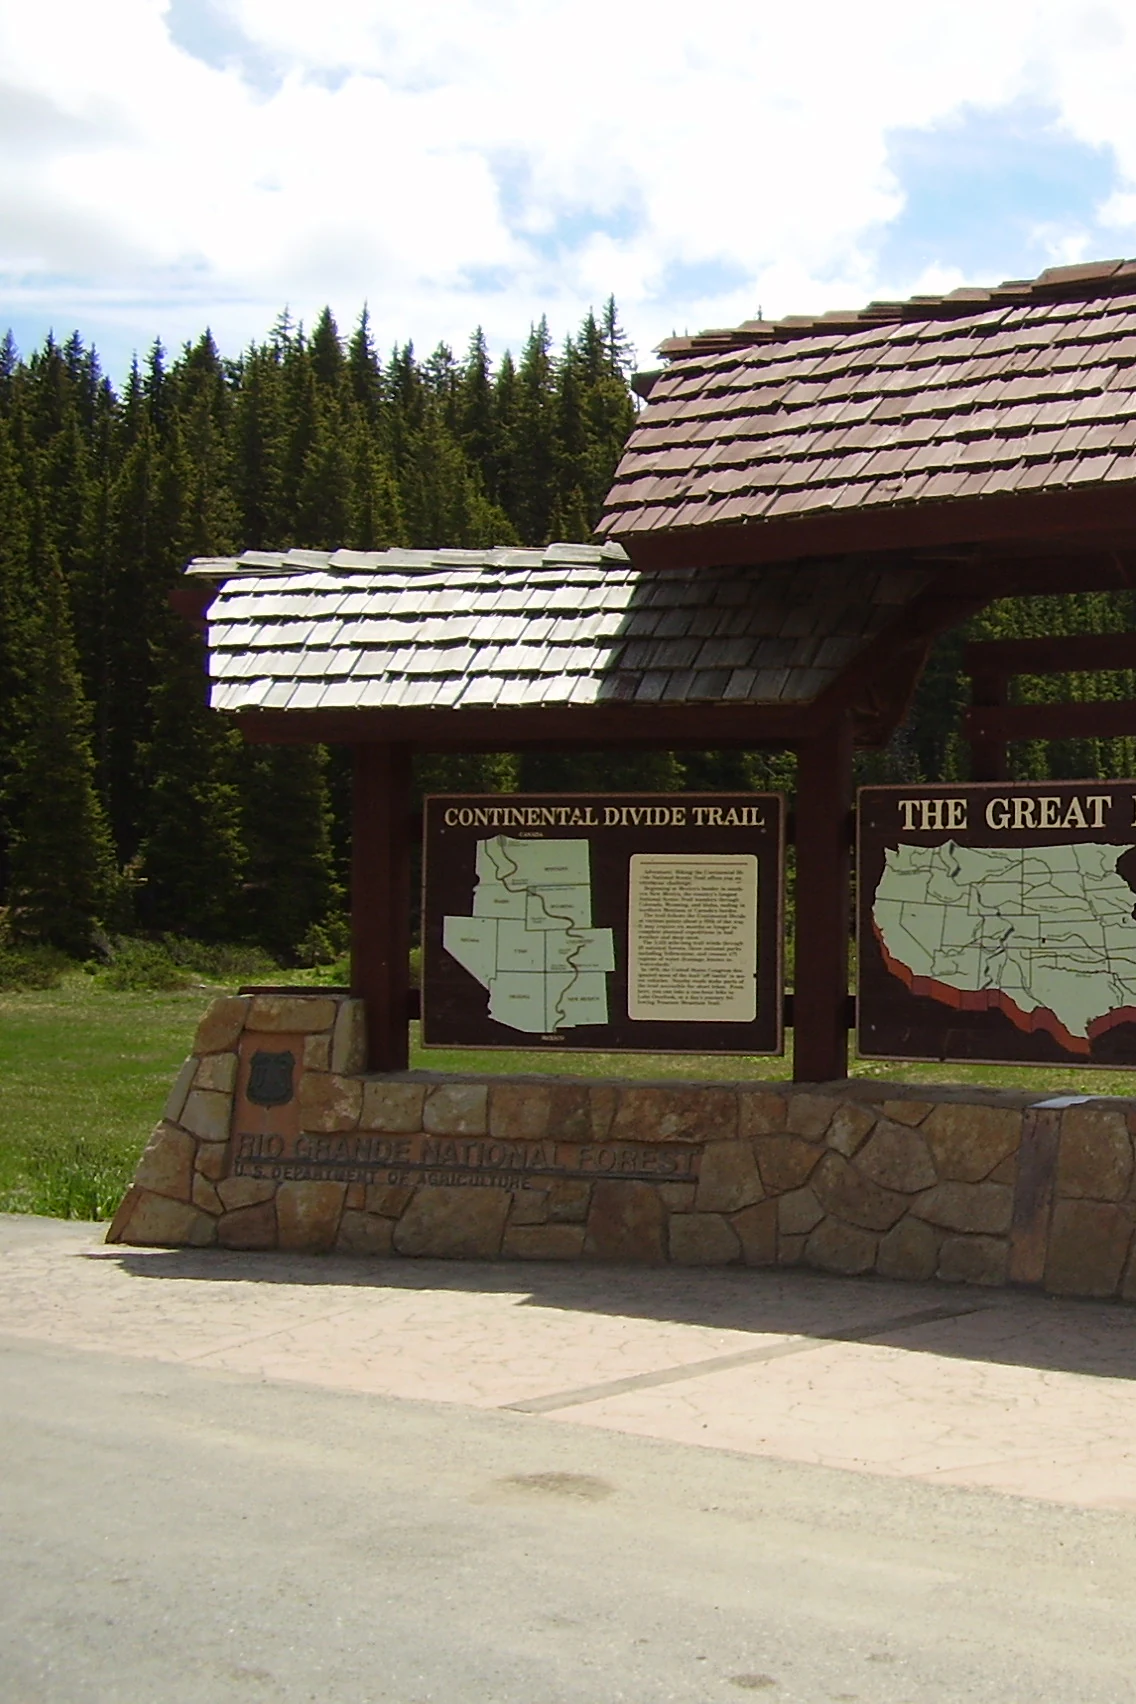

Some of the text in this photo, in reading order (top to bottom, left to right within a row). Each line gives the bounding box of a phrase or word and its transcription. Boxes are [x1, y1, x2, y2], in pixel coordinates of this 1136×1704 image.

[444, 807, 765, 826] CONTINENTAL DIVIDE TRAIL
[898, 798, 967, 831] THE
[986, 796, 1112, 830] GREAT
[236, 1132, 702, 1174] RIO GRANDE NATIONAL FOREST
[271, 1165, 379, 1184] DEPARTMENT
[387, 1170, 410, 1186] OF
[417, 1171, 533, 1191] AGRICULTURE
